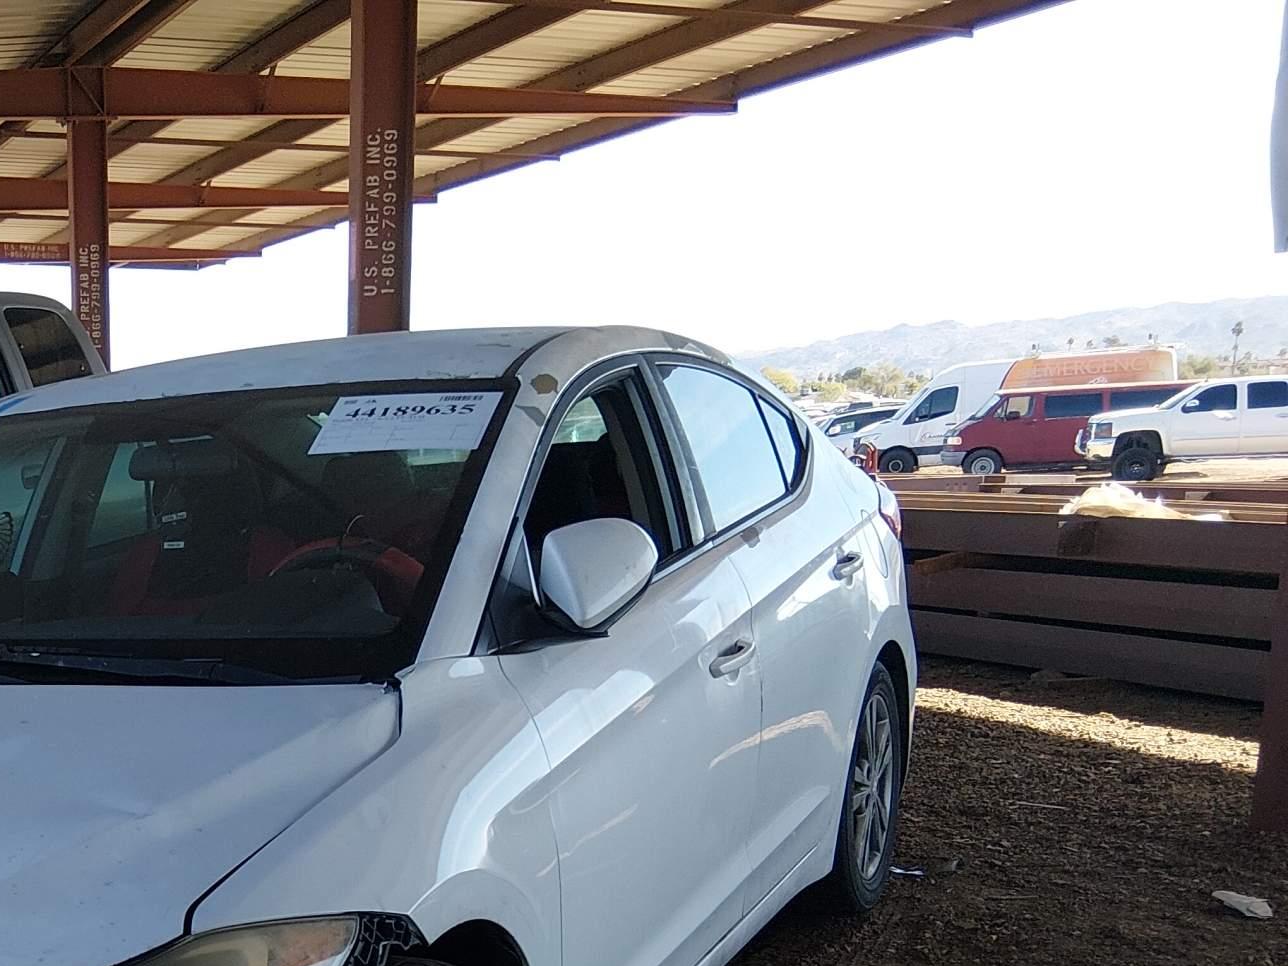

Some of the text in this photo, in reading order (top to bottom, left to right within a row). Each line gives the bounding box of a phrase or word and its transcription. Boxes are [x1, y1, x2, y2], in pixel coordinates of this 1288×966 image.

[363, 127, 382, 297] U.S. PREFAB INC.
[381, 129, 398, 294] 1-866-799-0969
[79, 243, 90, 267] INC.
[79, 273, 90, 321] PREFAB
[1032, 356, 1160, 378] EMERGENCY
[345, 403, 477, 418] 44189635
